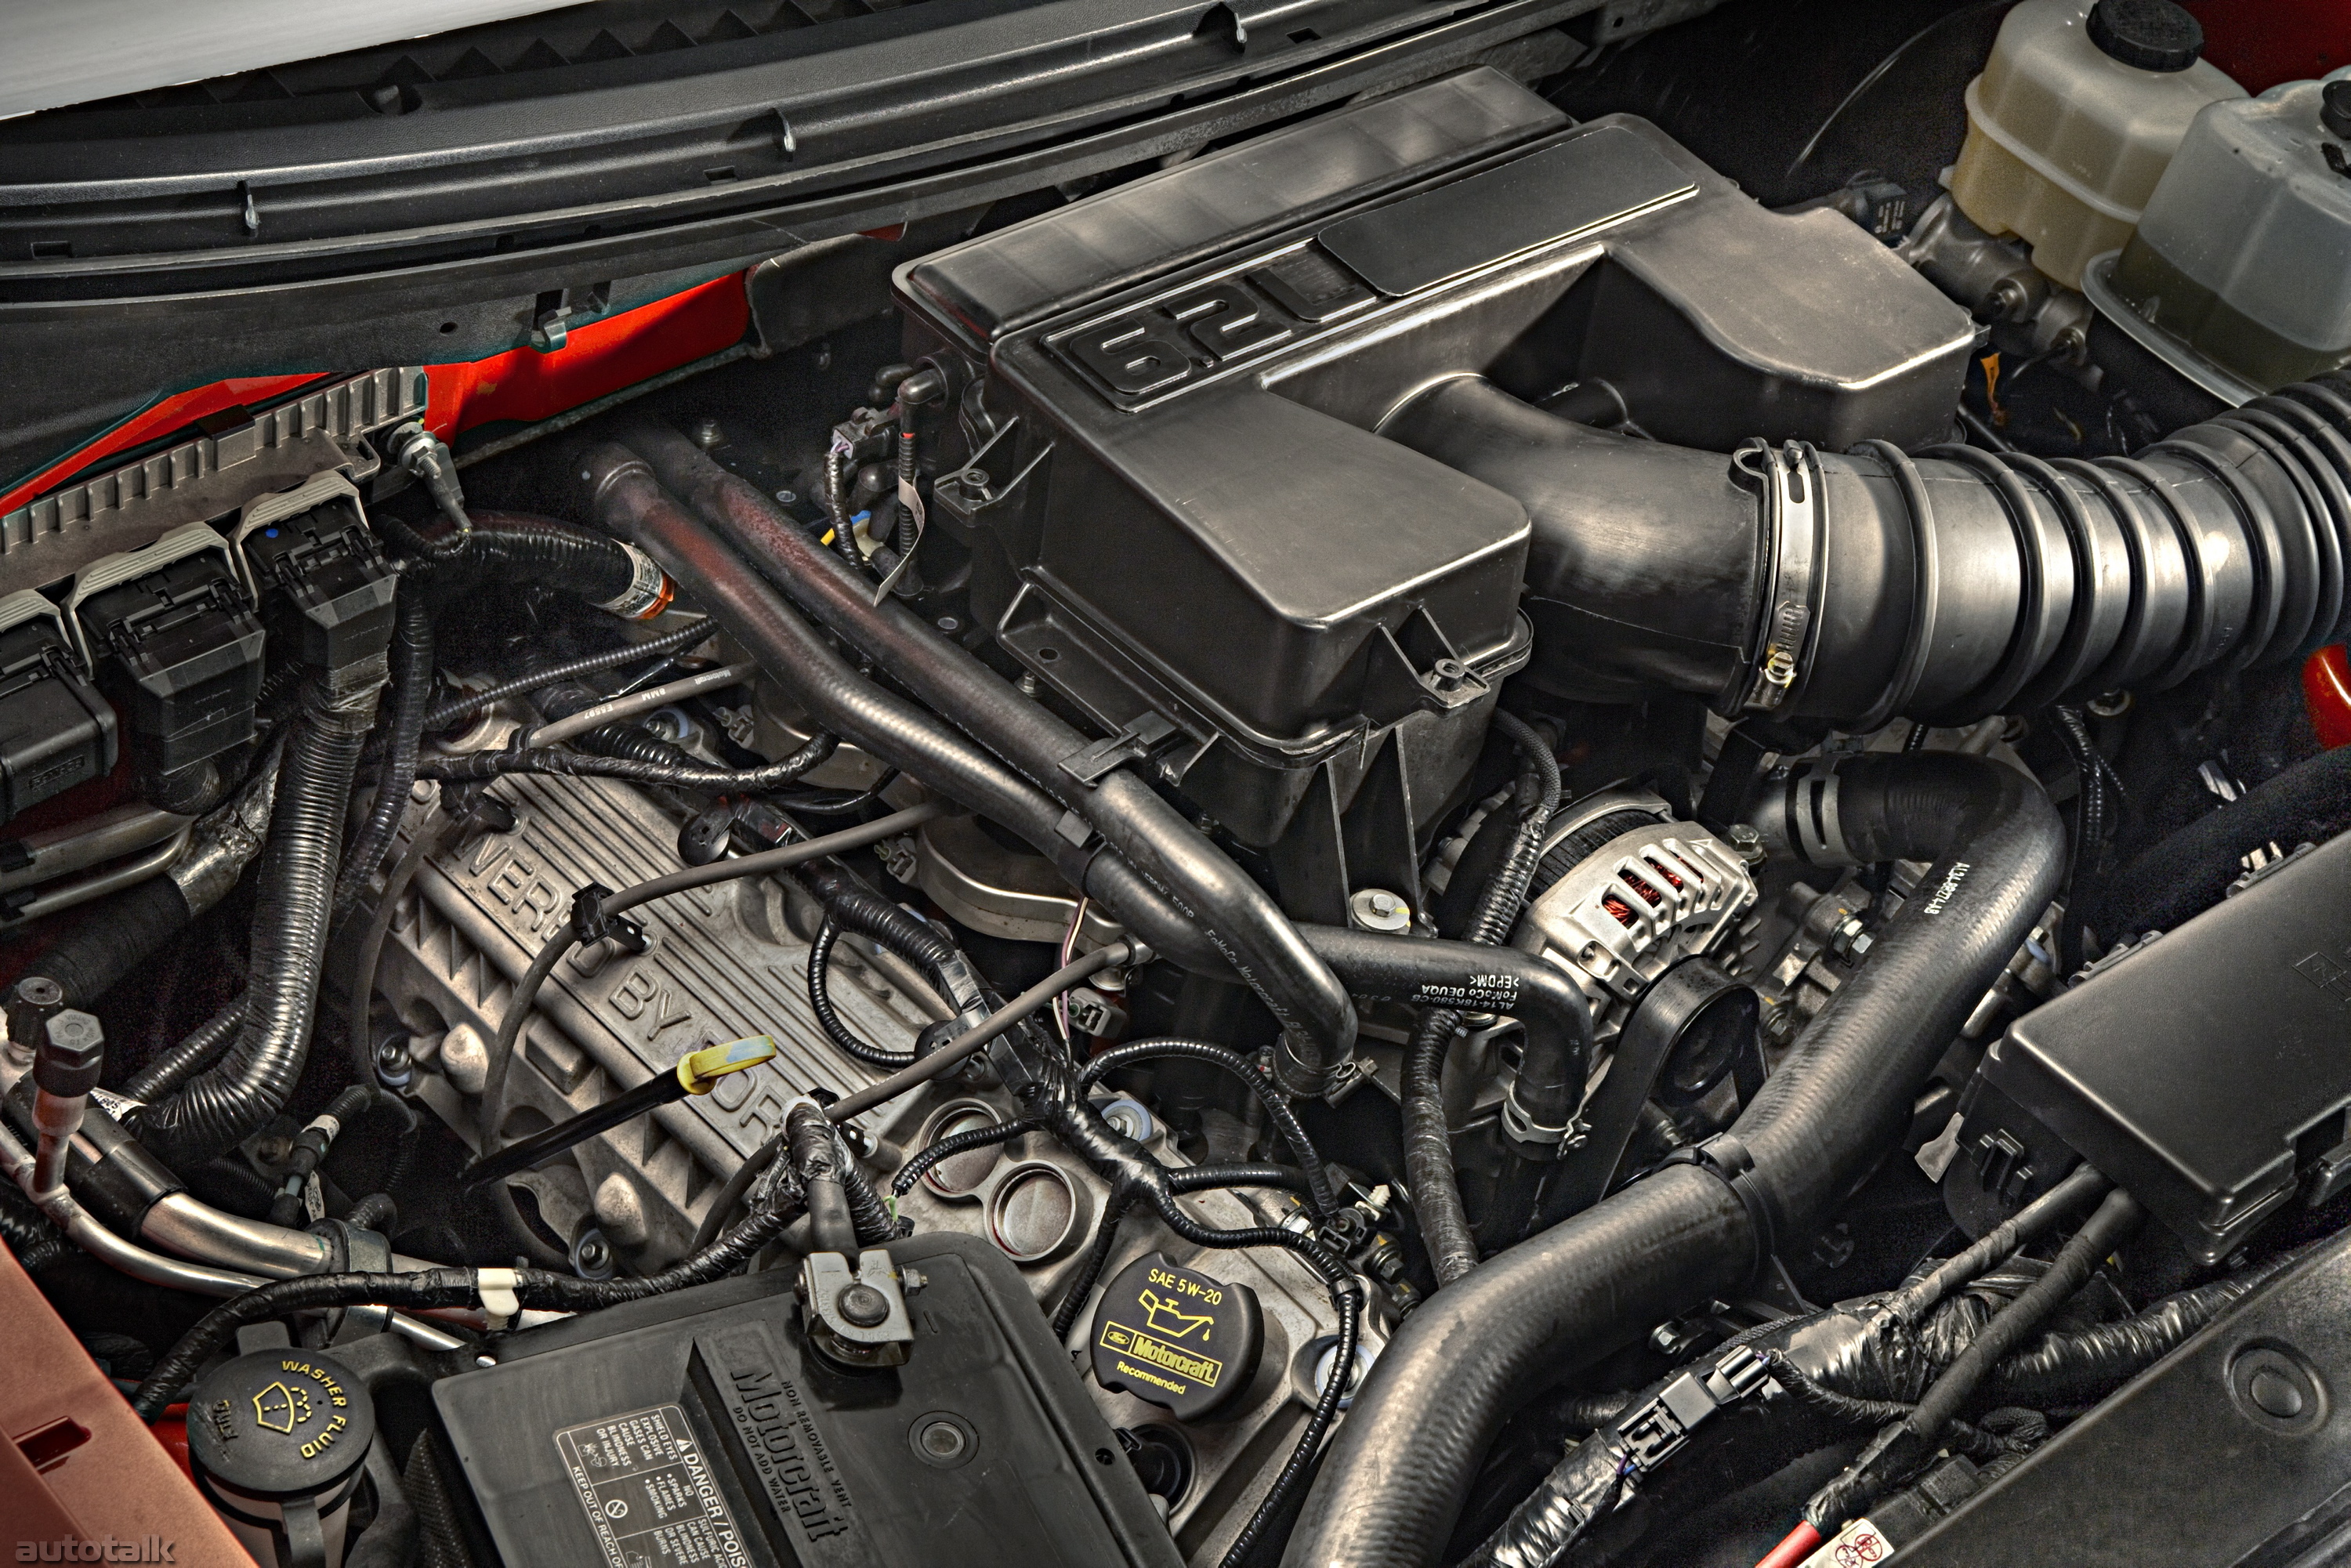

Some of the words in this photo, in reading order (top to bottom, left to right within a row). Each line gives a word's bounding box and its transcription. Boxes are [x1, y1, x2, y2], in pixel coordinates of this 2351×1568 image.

[642, 688, 666, 701] 8MM
[1204, 929, 1237, 964] FoMoCo
[609, 965, 692, 1041] BY
[1148, 1268, 1176, 1289] SAE
[1176, 1278, 1223, 1306] 5W-20
[281, 1360, 347, 1408] WASHER
[1117, 1360, 1186, 1395] Recommended
[300, 1414, 347, 1459] FLUID
[596, 1428, 608, 1439] OR
[607, 1425, 632, 1466] BLINDNESS
[618, 1422, 636, 1447] CAUSE
[629, 1420, 647, 1444] GASES
[639, 1444, 654, 1461] CAN
[639, 1417, 665, 1457] EXPLOSIVE
[781, 1380, 802, 1407] NON
[795, 1410, 835, 1473] REMOVABLE
[831, 1479, 853, 1508] VENT
[730, 1371, 849, 1542] Motorcraft
[733, 1406, 748, 1423] DO
[742, 1426, 761, 1448] NOT
[755, 1452, 772, 1475] ADD
[768, 1477, 792, 1513] WATER
[572, 1465, 589, 1490] KEEP
[683, 1484, 694, 1497] NO
[583, 1490, 598, 1508] OUT
[592, 1510, 604, 1523] OF
[683, 1453, 723, 1519] DANGER
[719, 1530, 747, 1568] POIS
[597, 1524, 618, 1555] REACH
[665, 1526, 676, 1538] OR
[676, 1524, 700, 1563] BLINDNESS
[686, 1521, 701, 1537] CAN
[694, 1537, 712, 1560] CAUSE
[697, 1519, 719, 1553] SULFURIC
[669, 1538, 689, 1566] SEVERE
